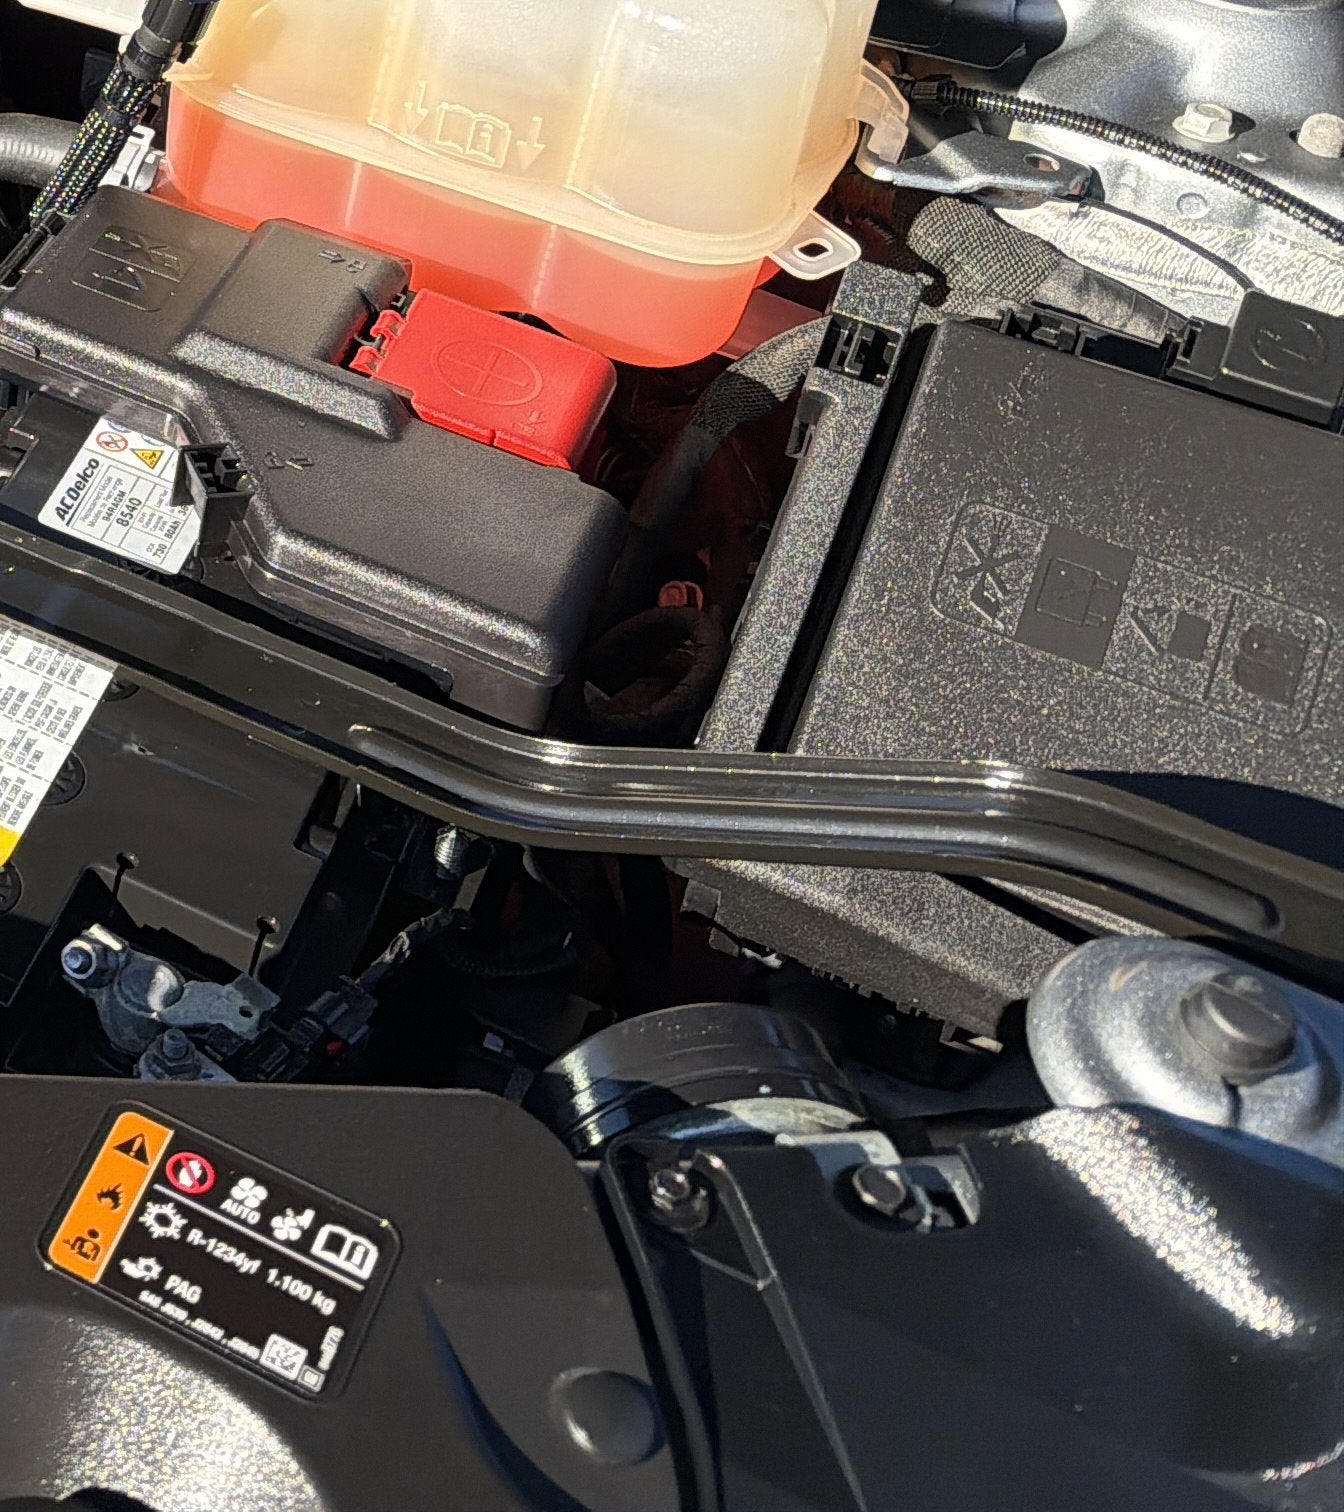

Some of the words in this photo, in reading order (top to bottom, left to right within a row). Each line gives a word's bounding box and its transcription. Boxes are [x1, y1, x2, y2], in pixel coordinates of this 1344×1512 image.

[55, 458, 100, 522] ACDelco
[115, 497, 142, 527] 8540
[163, 520, 182, 540] 80Ah
[152, 543, 168, 559] 730
[220, 1197, 261, 1225] AUTO
[185, 1228, 262, 1275] R-1234yf
[265, 1268, 312, 1302] 1.100
[311, 1289, 337, 1316] kg
[163, 1274, 202, 1304] PAG
